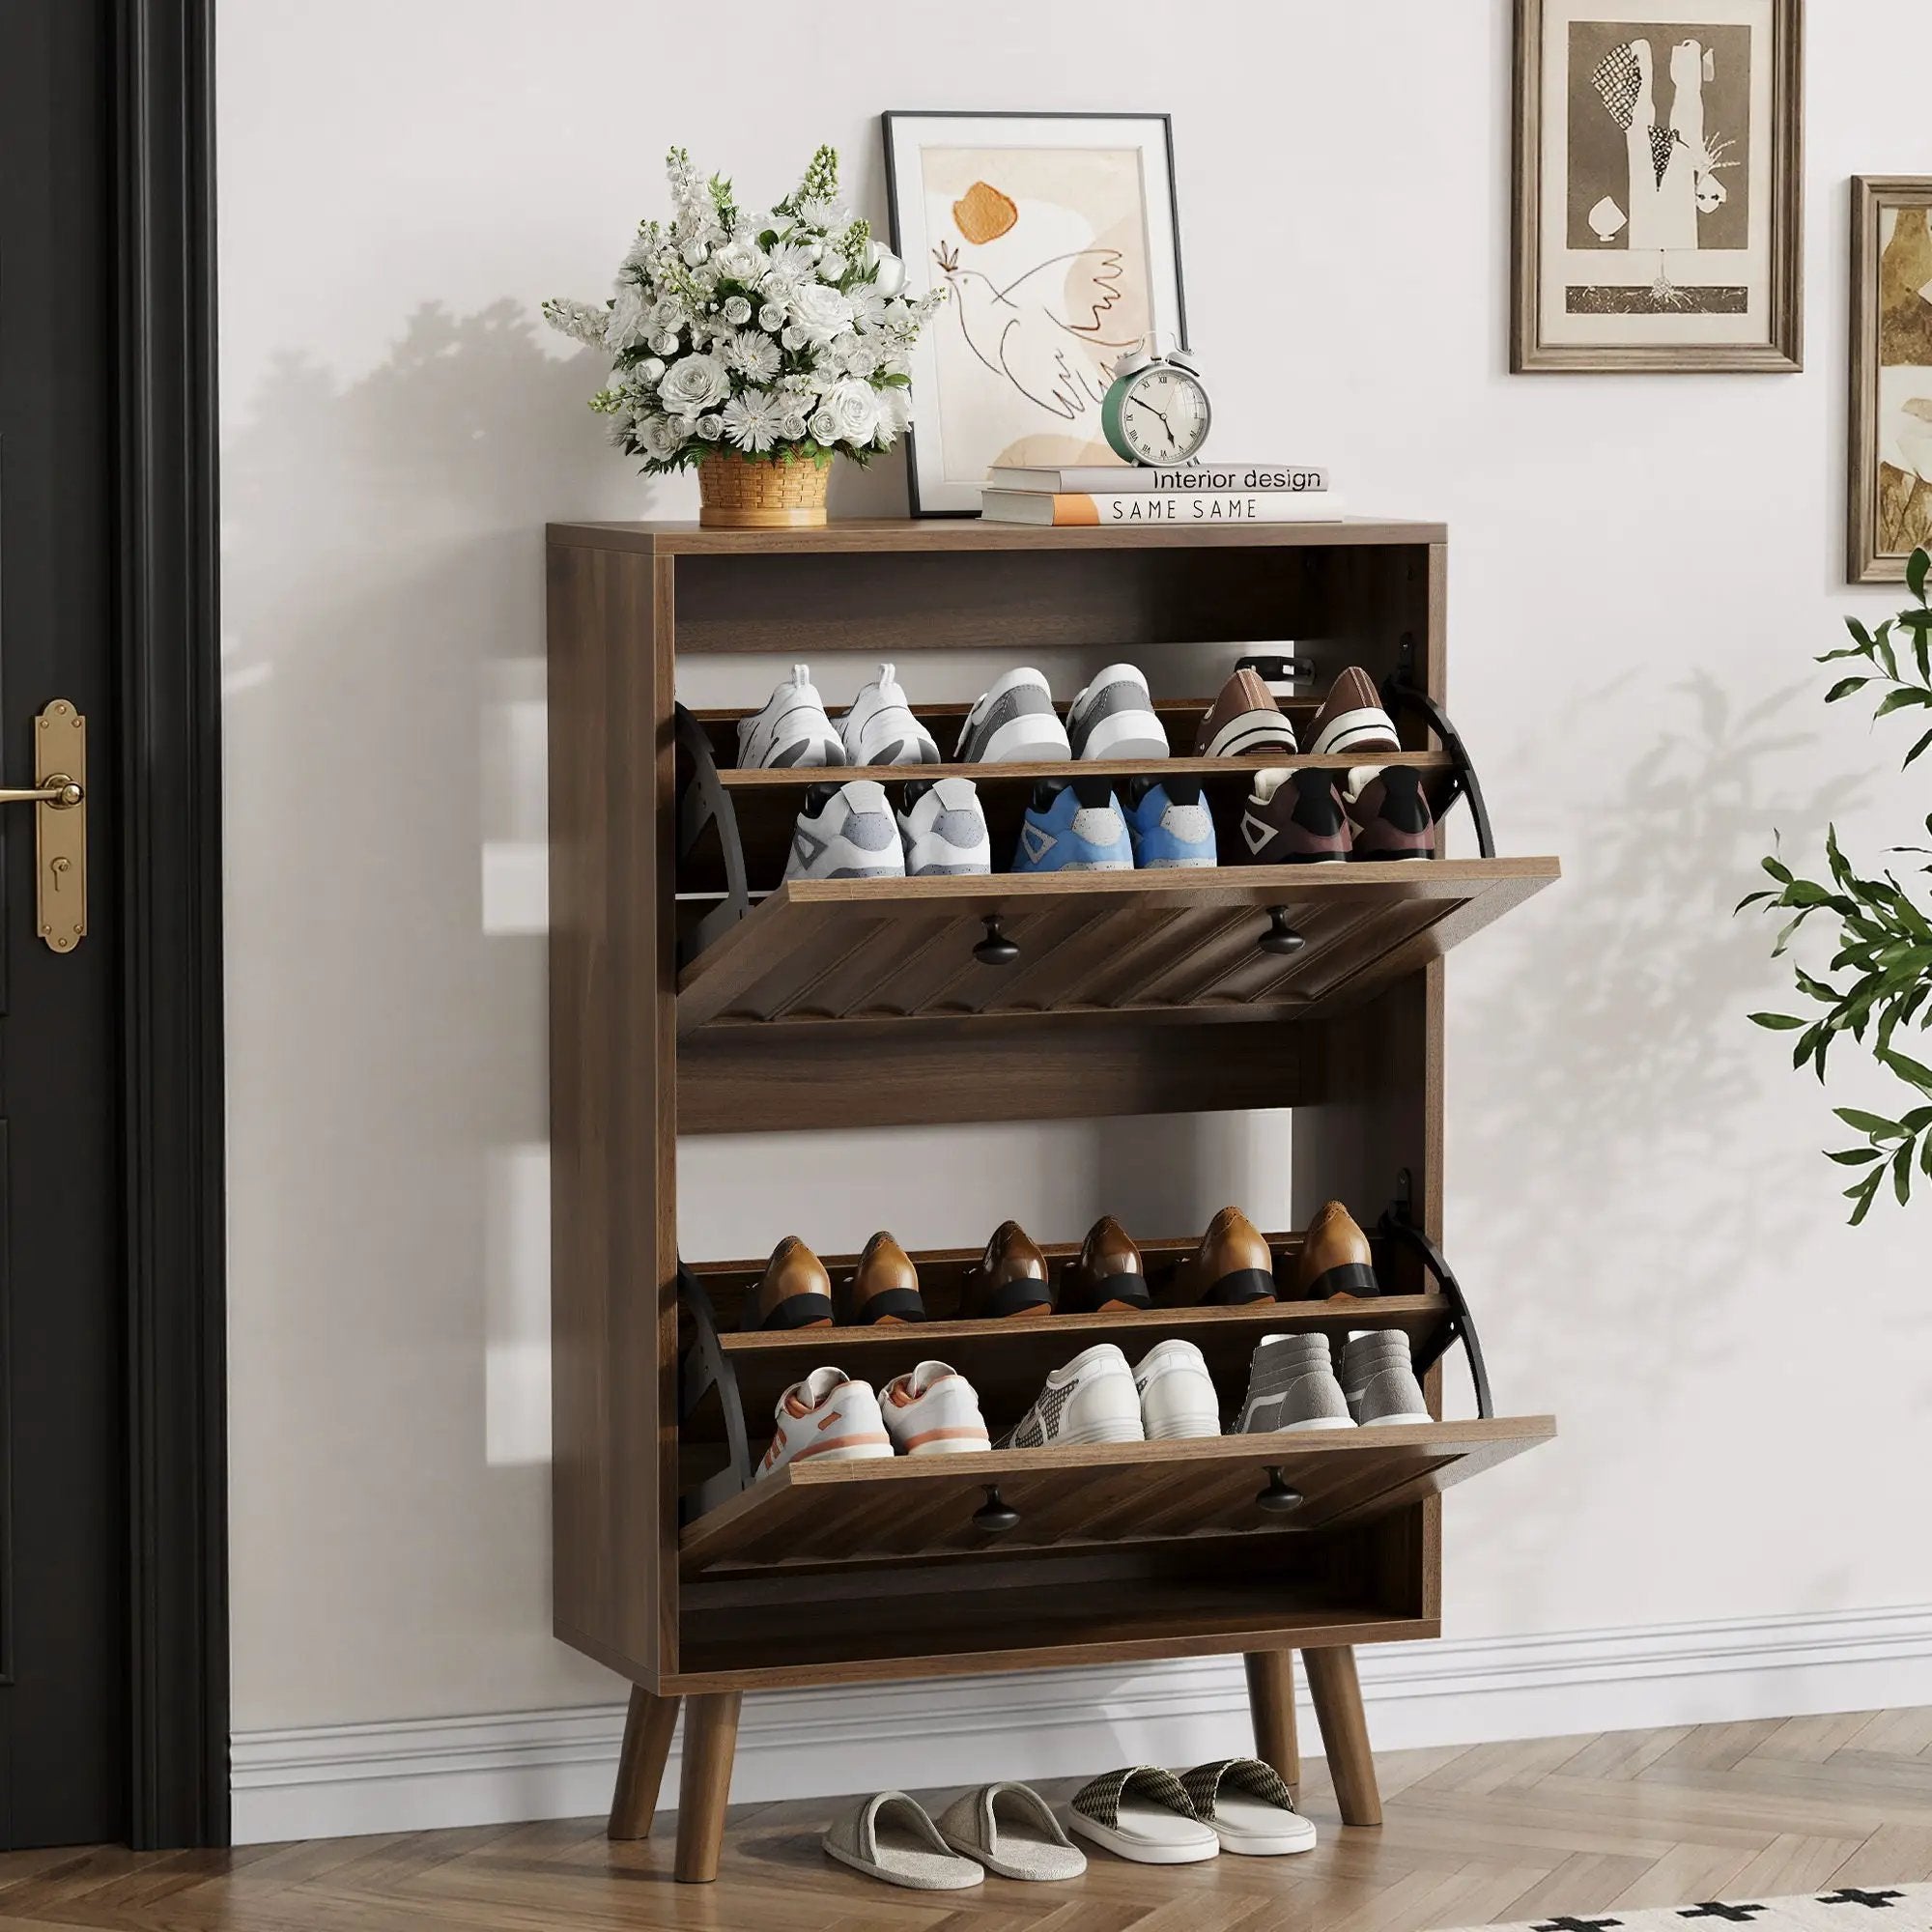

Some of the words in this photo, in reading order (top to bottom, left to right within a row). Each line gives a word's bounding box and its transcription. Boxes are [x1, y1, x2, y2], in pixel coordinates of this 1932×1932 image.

[1153, 469, 1236, 489] Interior
[1244, 469, 1321, 492] design
[1113, 499, 1176, 520] SAME
[1193, 498, 1256, 519] SAME
